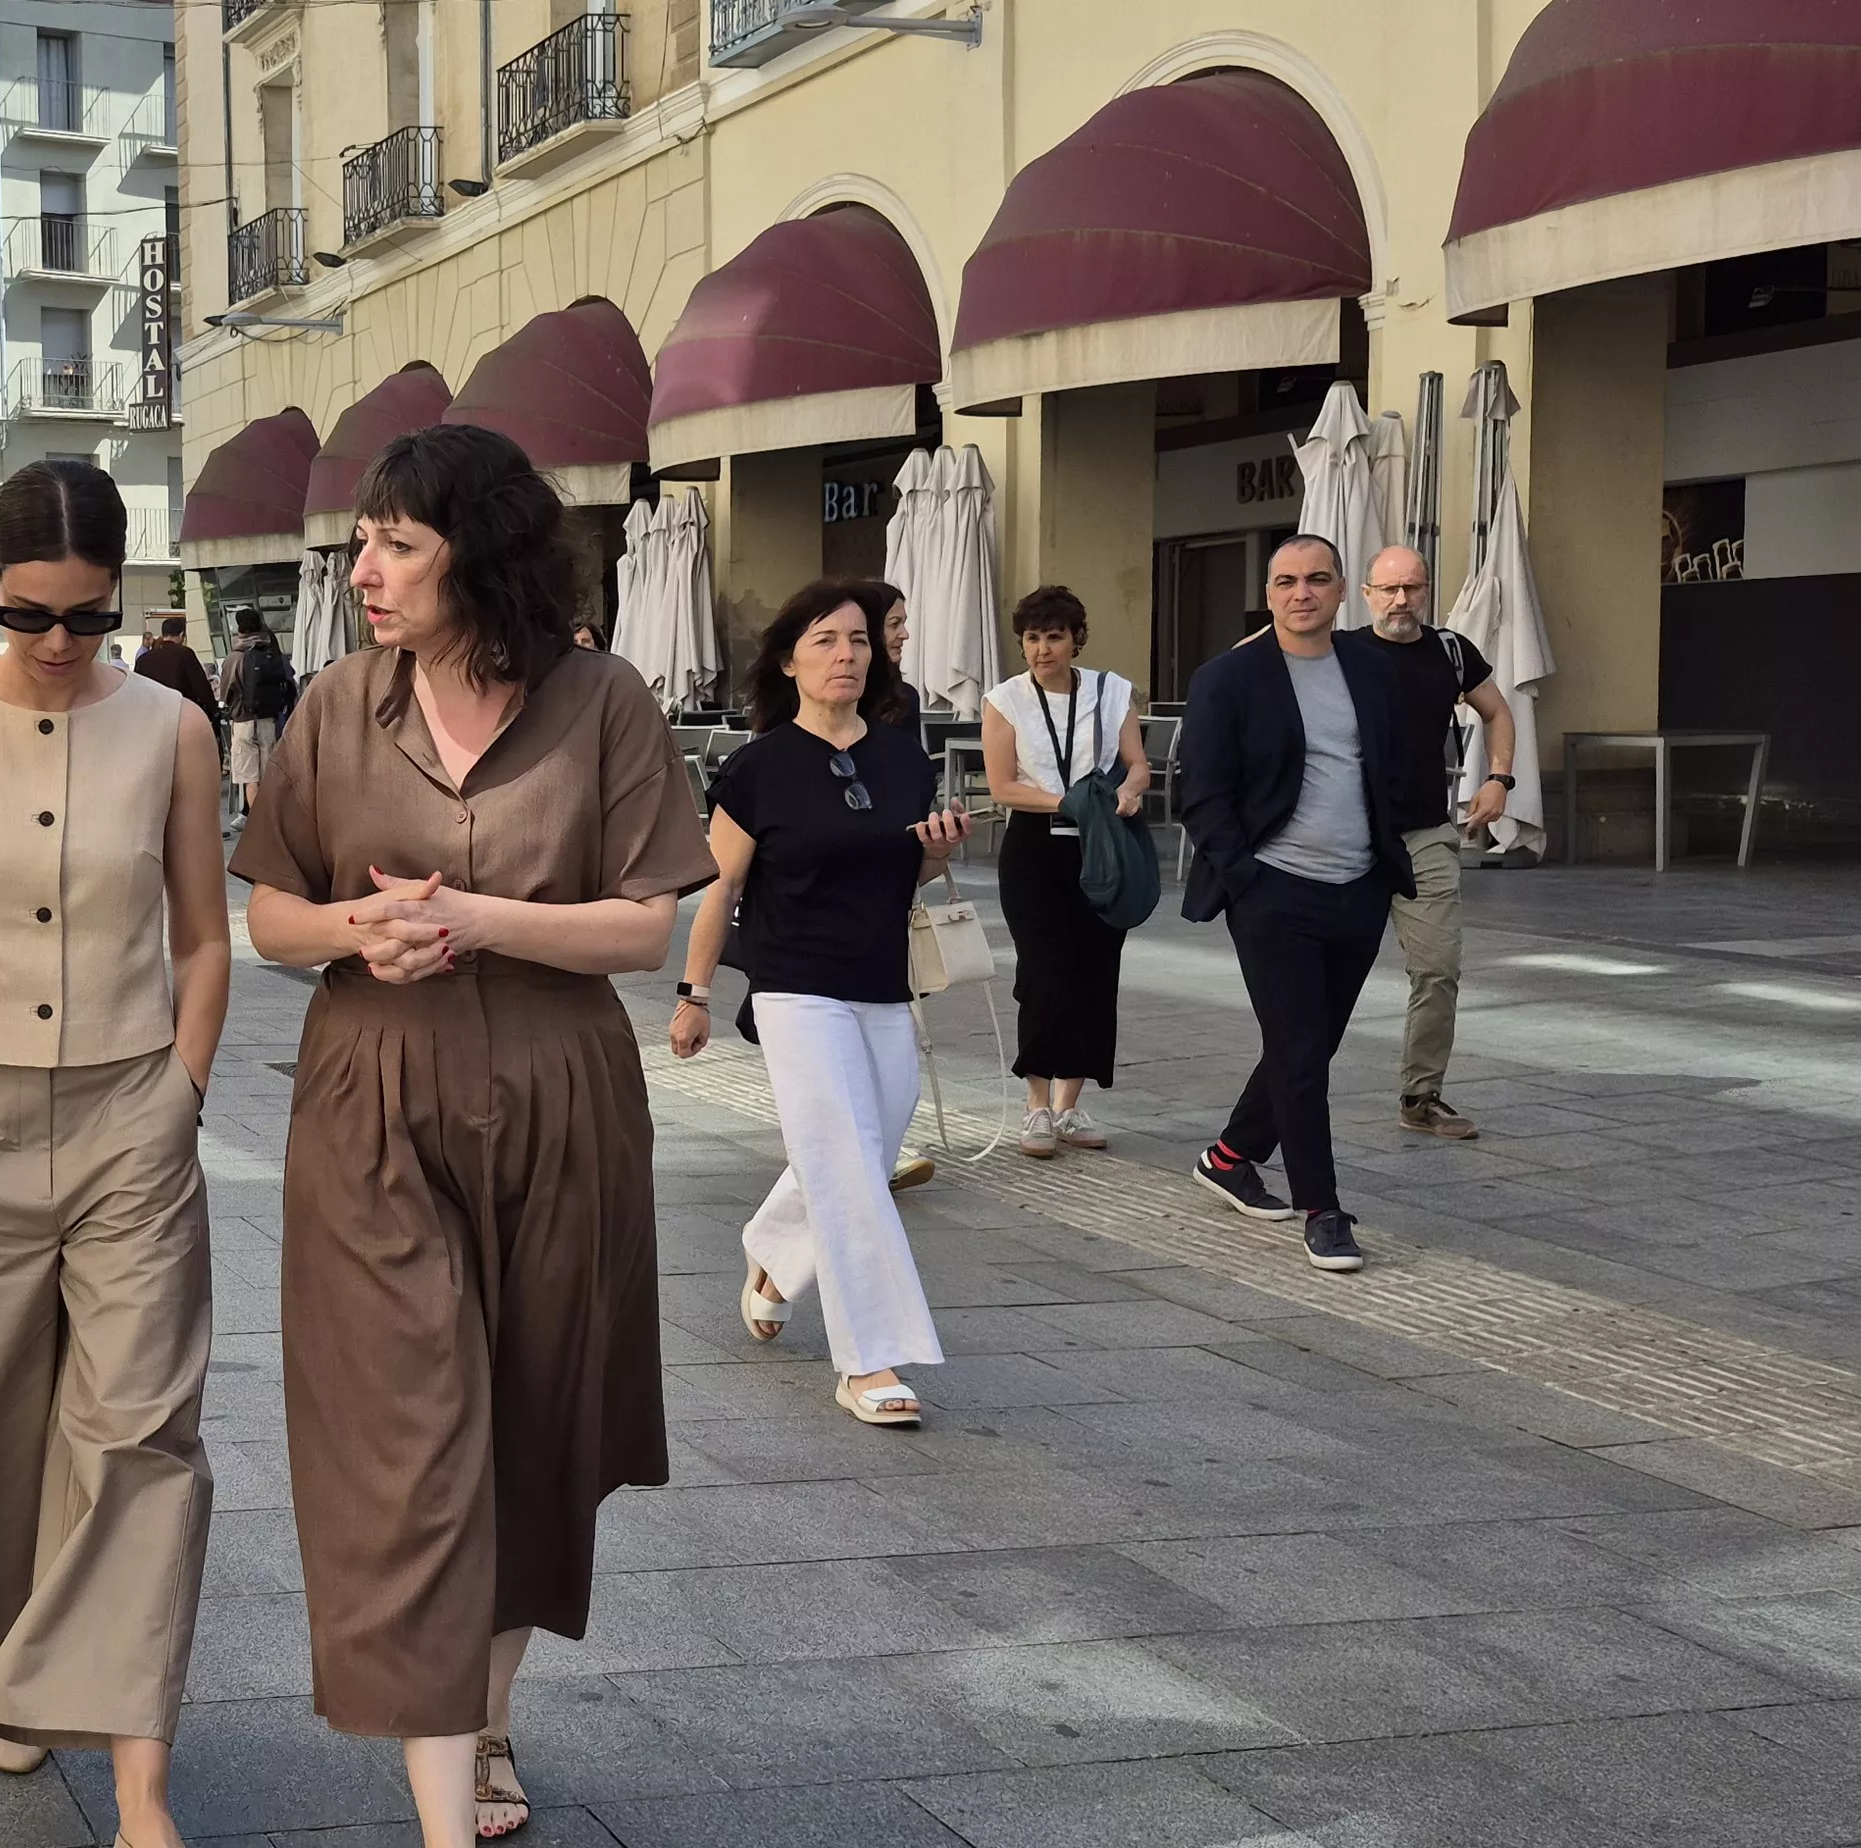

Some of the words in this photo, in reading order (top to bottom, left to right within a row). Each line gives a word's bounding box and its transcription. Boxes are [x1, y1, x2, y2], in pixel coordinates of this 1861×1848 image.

[142, 241, 166, 398] HOSTAL
[824, 482, 878, 522] Bar
[1236, 454, 1297, 505] BAR
